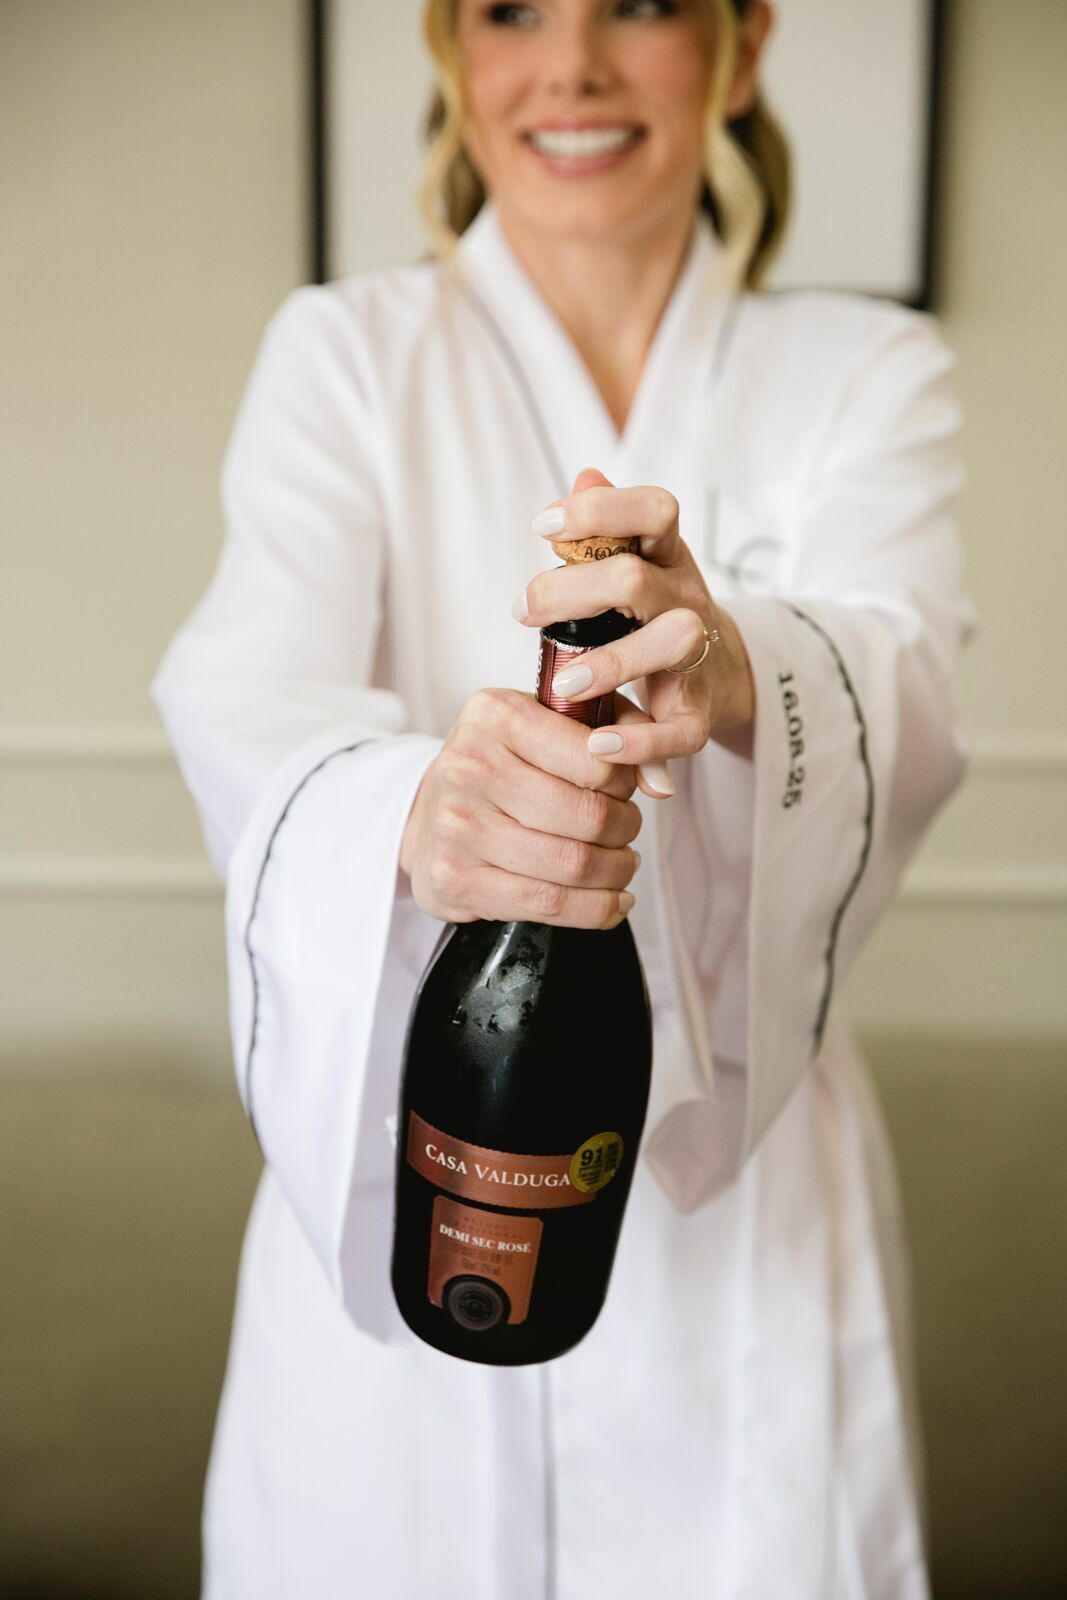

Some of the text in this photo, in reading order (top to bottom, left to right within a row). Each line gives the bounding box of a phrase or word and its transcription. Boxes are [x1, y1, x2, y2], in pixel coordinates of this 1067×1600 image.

[425, 1144, 468, 1174] CASA
[474, 1164, 571, 1187] VALDUGA
[581, 1147, 603, 1167] 91
[439, 1223, 470, 1243] DEMI
[471, 1236, 495, 1249] SEC
[497, 1241, 532, 1253] ROSÉ
